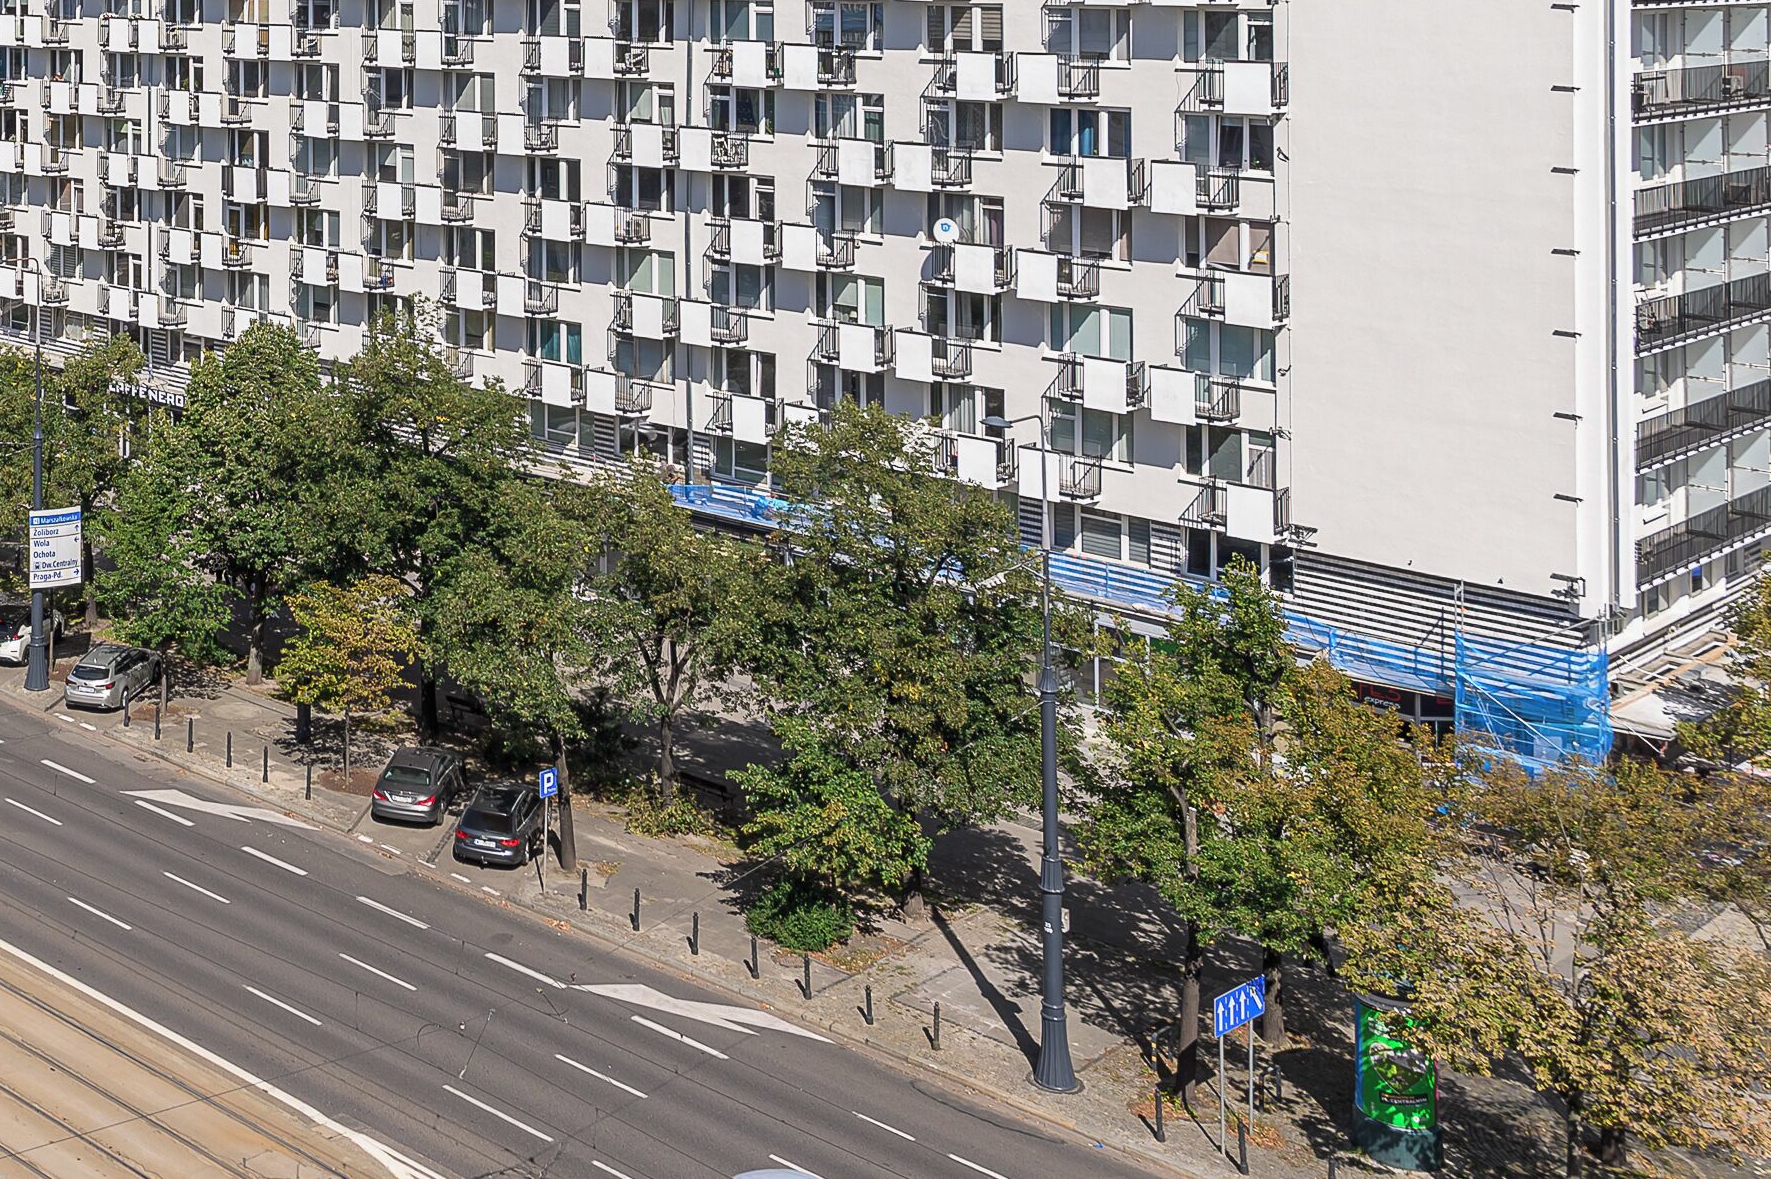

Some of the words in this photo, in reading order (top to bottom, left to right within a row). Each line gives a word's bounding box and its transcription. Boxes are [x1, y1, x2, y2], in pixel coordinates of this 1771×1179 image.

[148, 390, 184, 408] NERO
[40, 514, 78, 524] Marszałkowska
[33, 528, 59, 536] Żoliborz
[33, 539, 50, 547] Wola
[33, 550, 56, 559] Ochota
[1364, 696, 1401, 709] express
